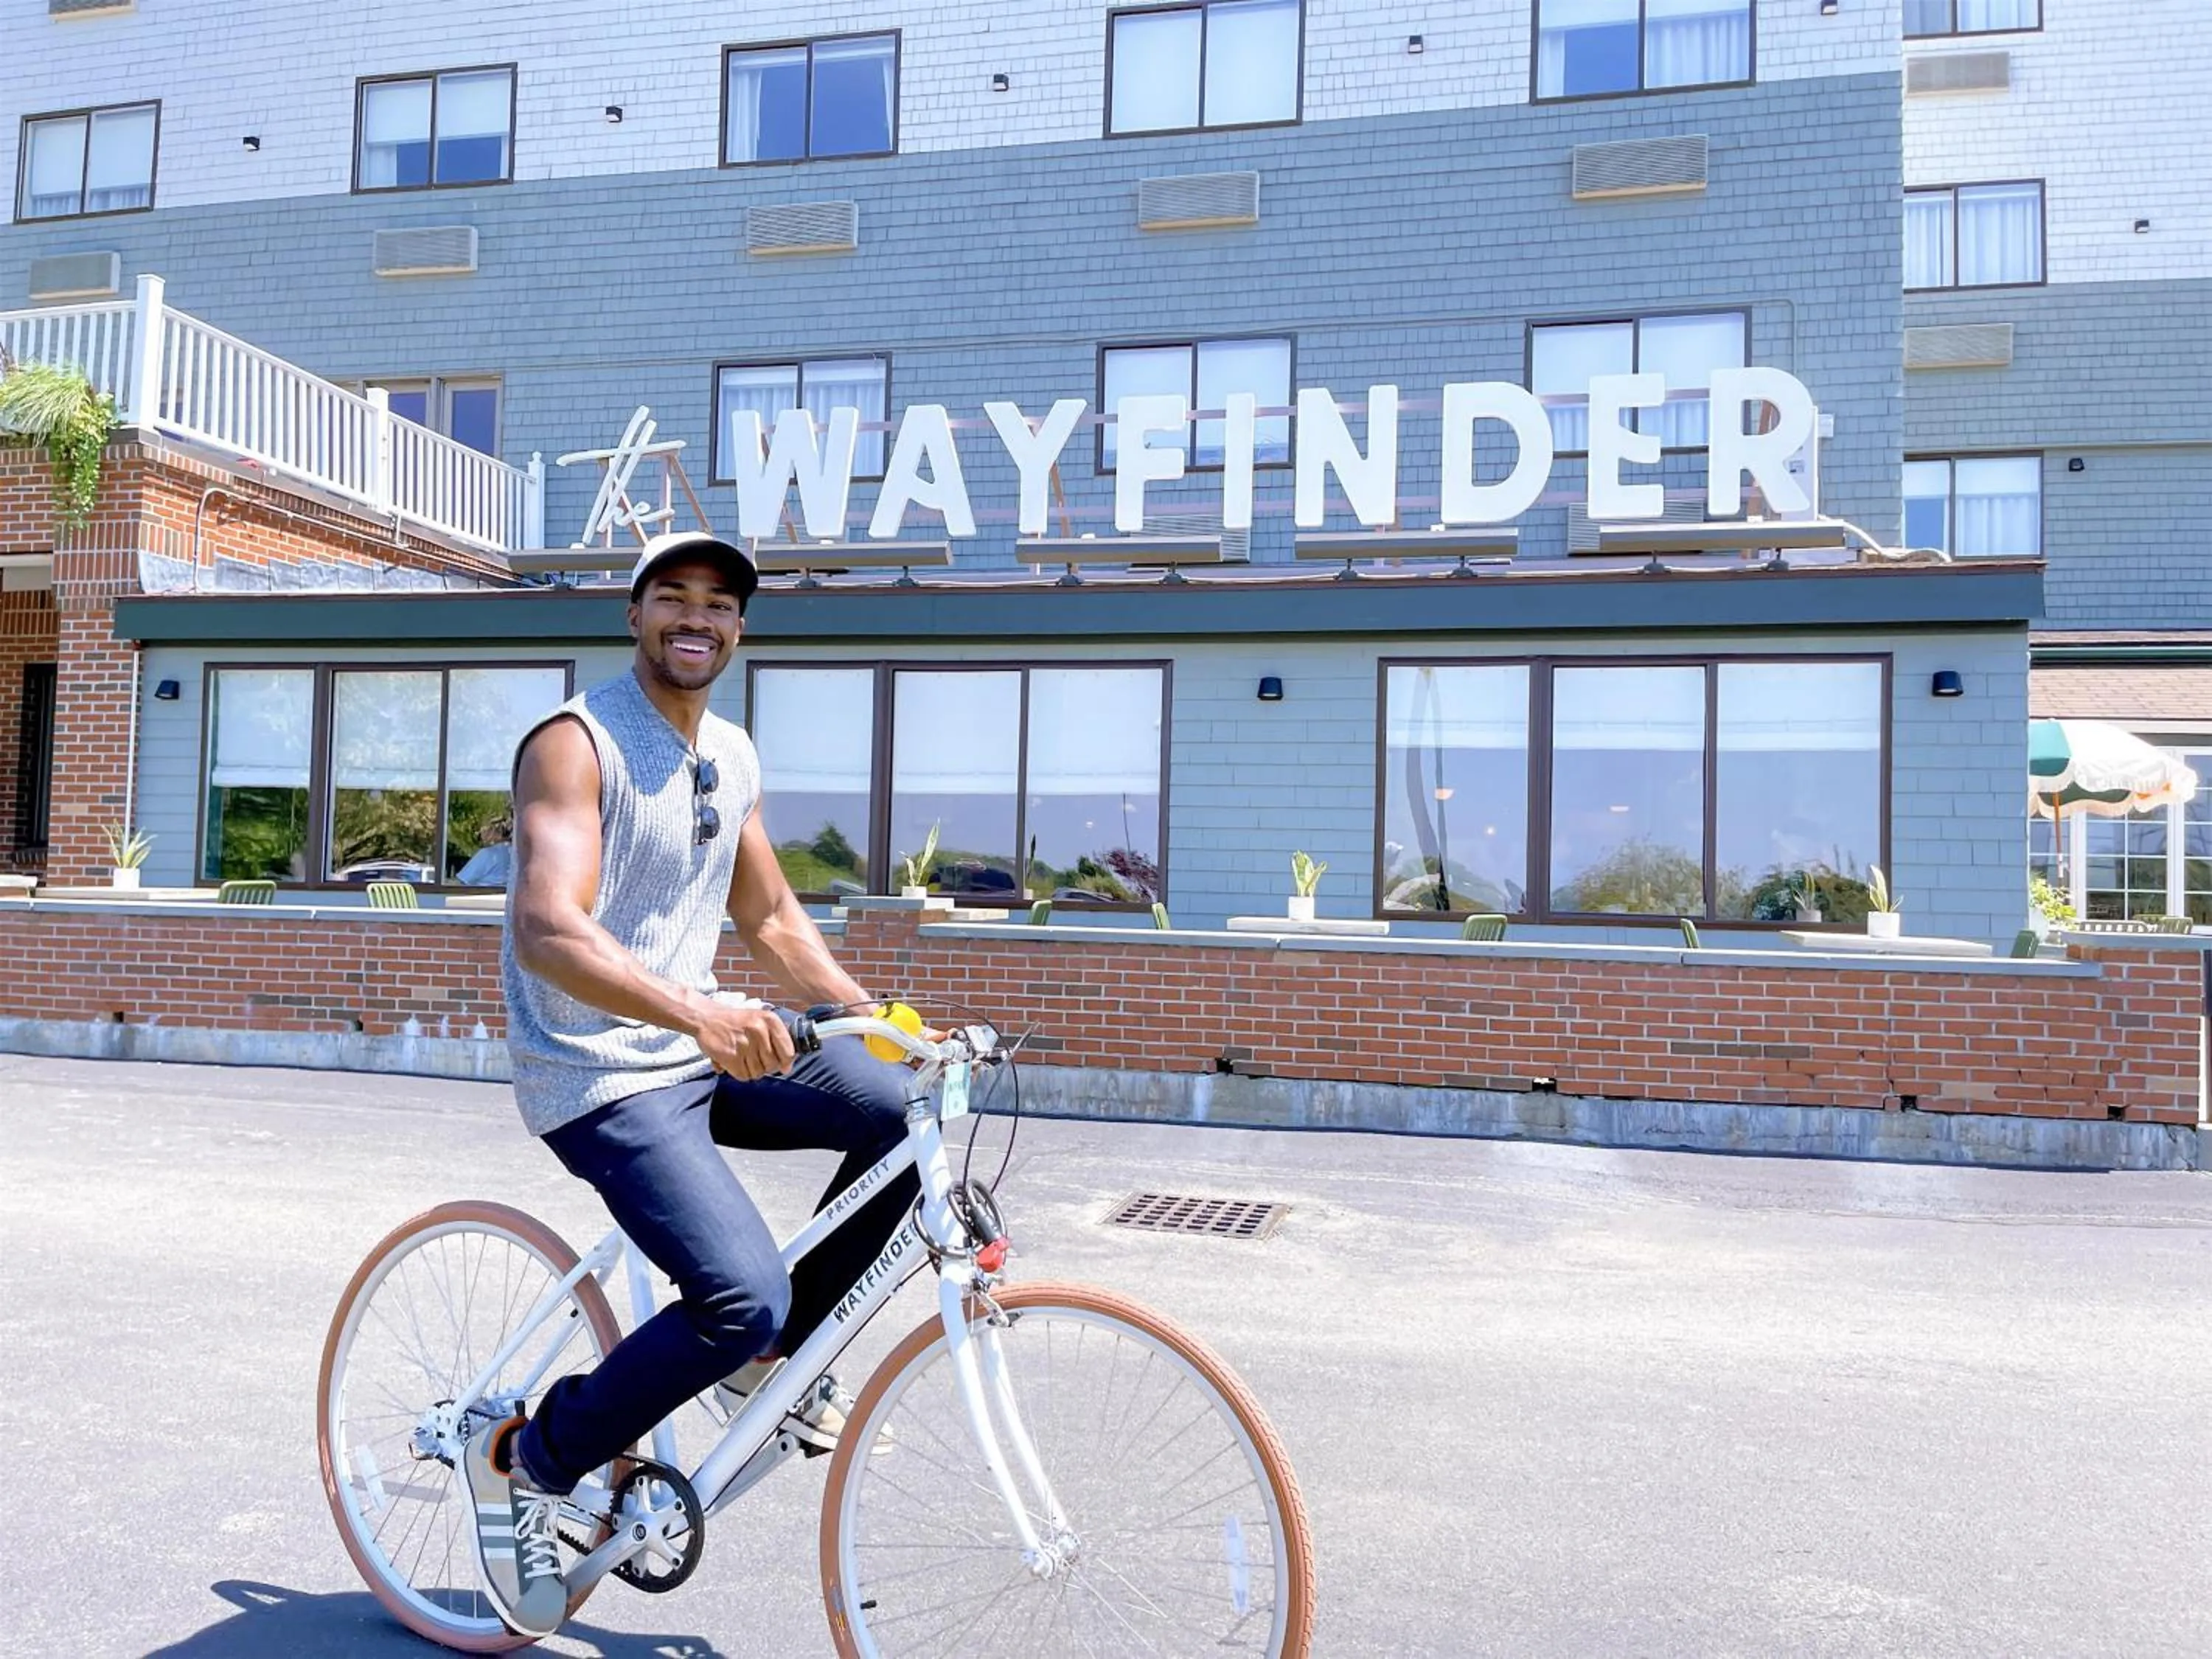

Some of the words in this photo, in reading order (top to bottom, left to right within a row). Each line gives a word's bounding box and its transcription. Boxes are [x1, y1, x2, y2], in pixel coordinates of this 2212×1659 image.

[556, 405, 686, 544] the
[731, 366, 1814, 539] WAYFINDER
[825, 1159, 891, 1220] PRIORITY
